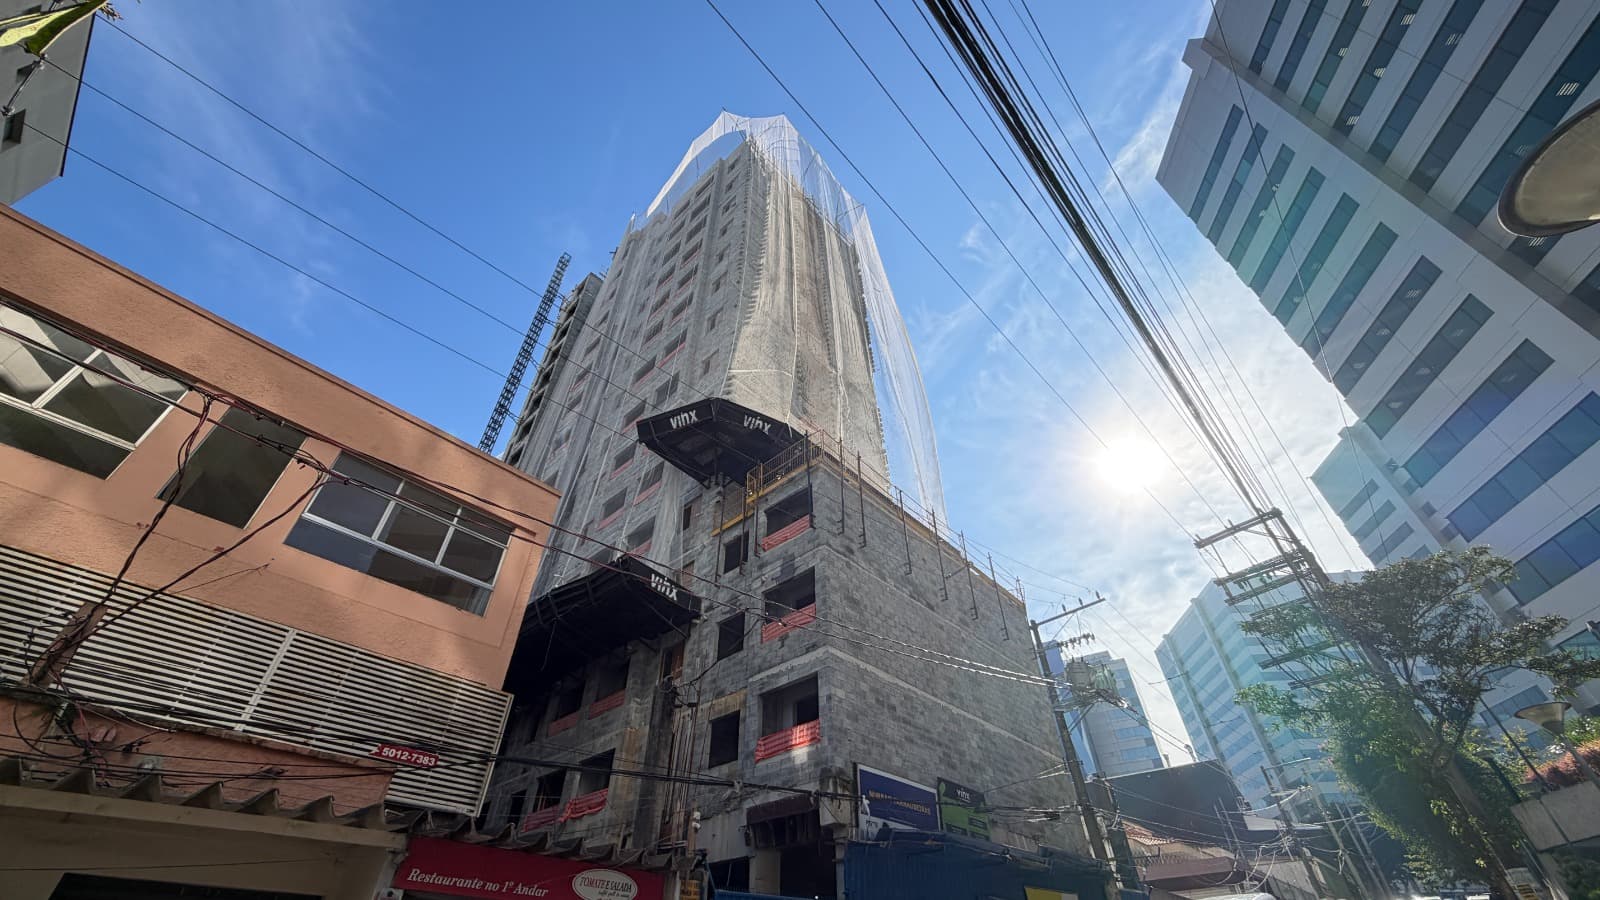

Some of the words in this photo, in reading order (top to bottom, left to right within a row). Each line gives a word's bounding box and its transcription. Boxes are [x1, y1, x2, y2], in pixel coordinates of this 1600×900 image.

[381, 746, 436, 766] 5012-7383
[407, 868, 483, 890] Restaurante
[484, 882, 500, 892] no
[513, 883, 549, 898] Andar
[610, 880, 632, 893] SALADA
